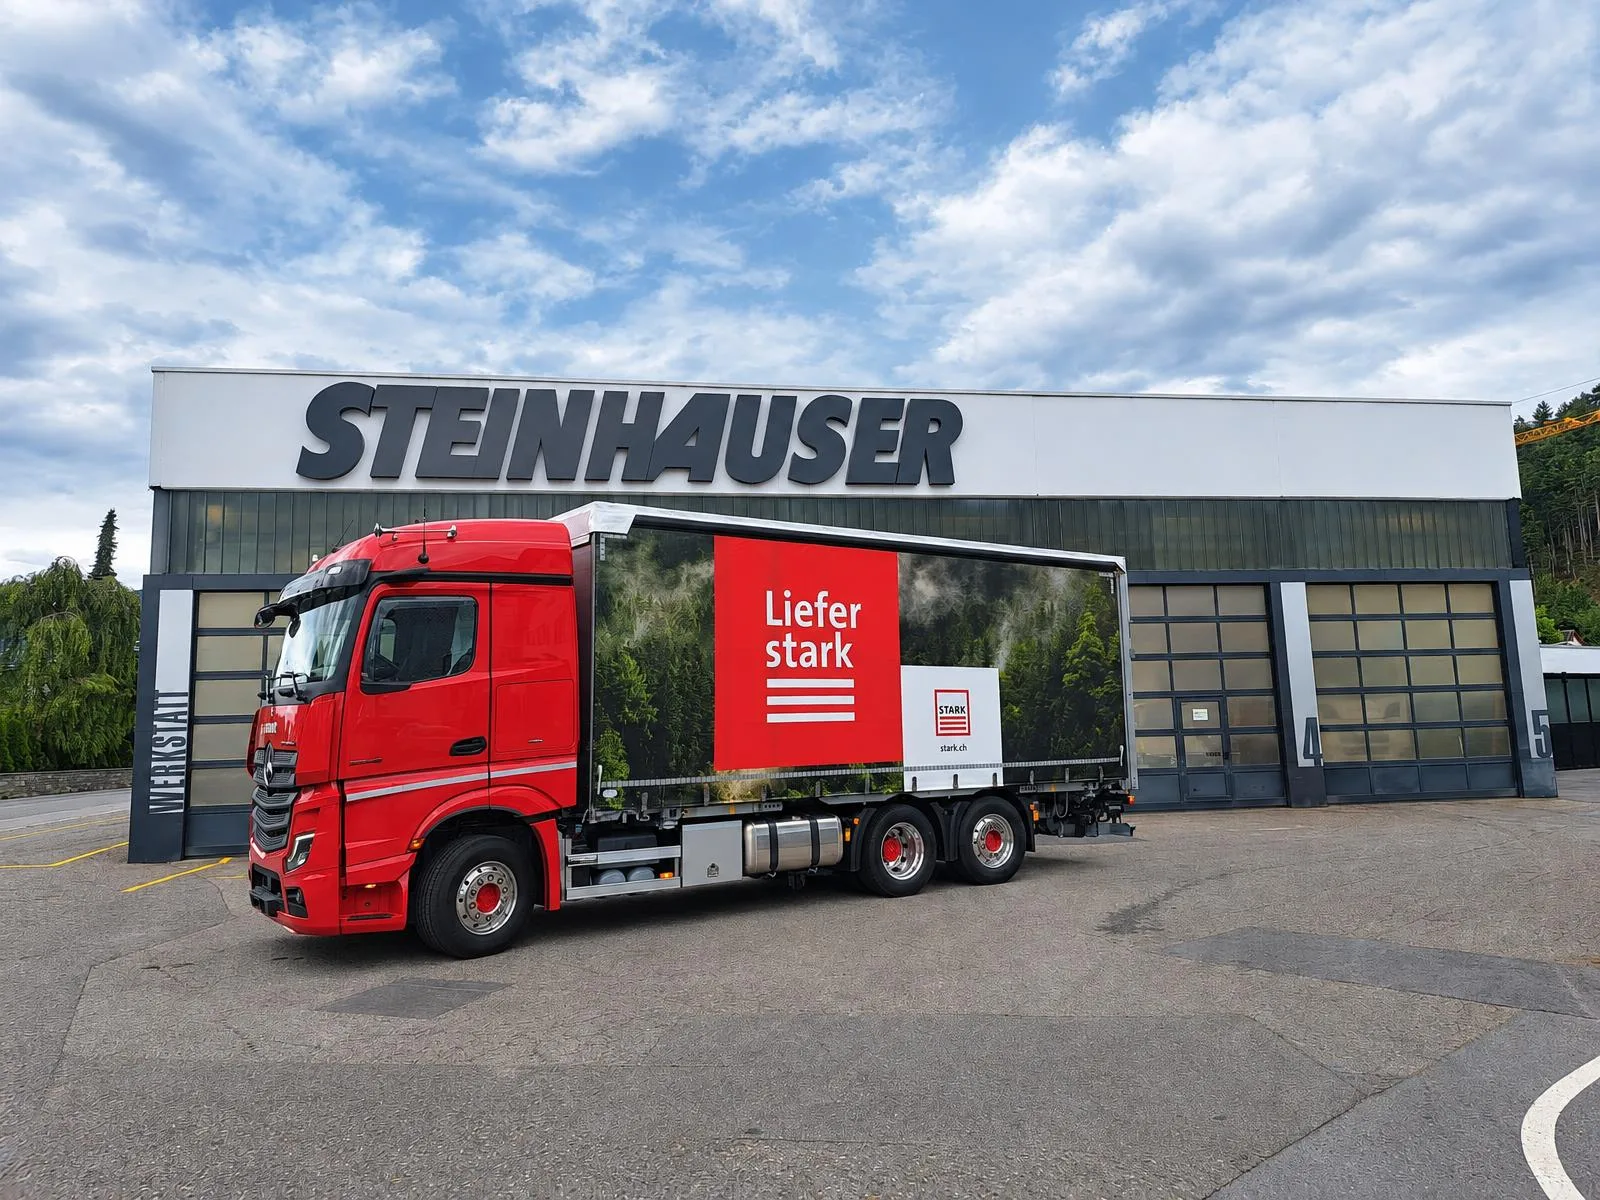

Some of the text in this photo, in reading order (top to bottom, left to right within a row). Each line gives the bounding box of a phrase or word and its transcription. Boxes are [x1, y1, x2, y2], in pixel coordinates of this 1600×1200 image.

[296, 381, 963, 486] STEINHAUSER
[766, 589, 862, 629] Liefer
[765, 631, 854, 668] stark
[938, 705, 966, 715] STARK
[149, 689, 189, 814] WERKSTATT
[940, 743, 968, 752] stark.ch
[1302, 716, 1323, 767] 4
[1531, 709, 1553, 758] 5
